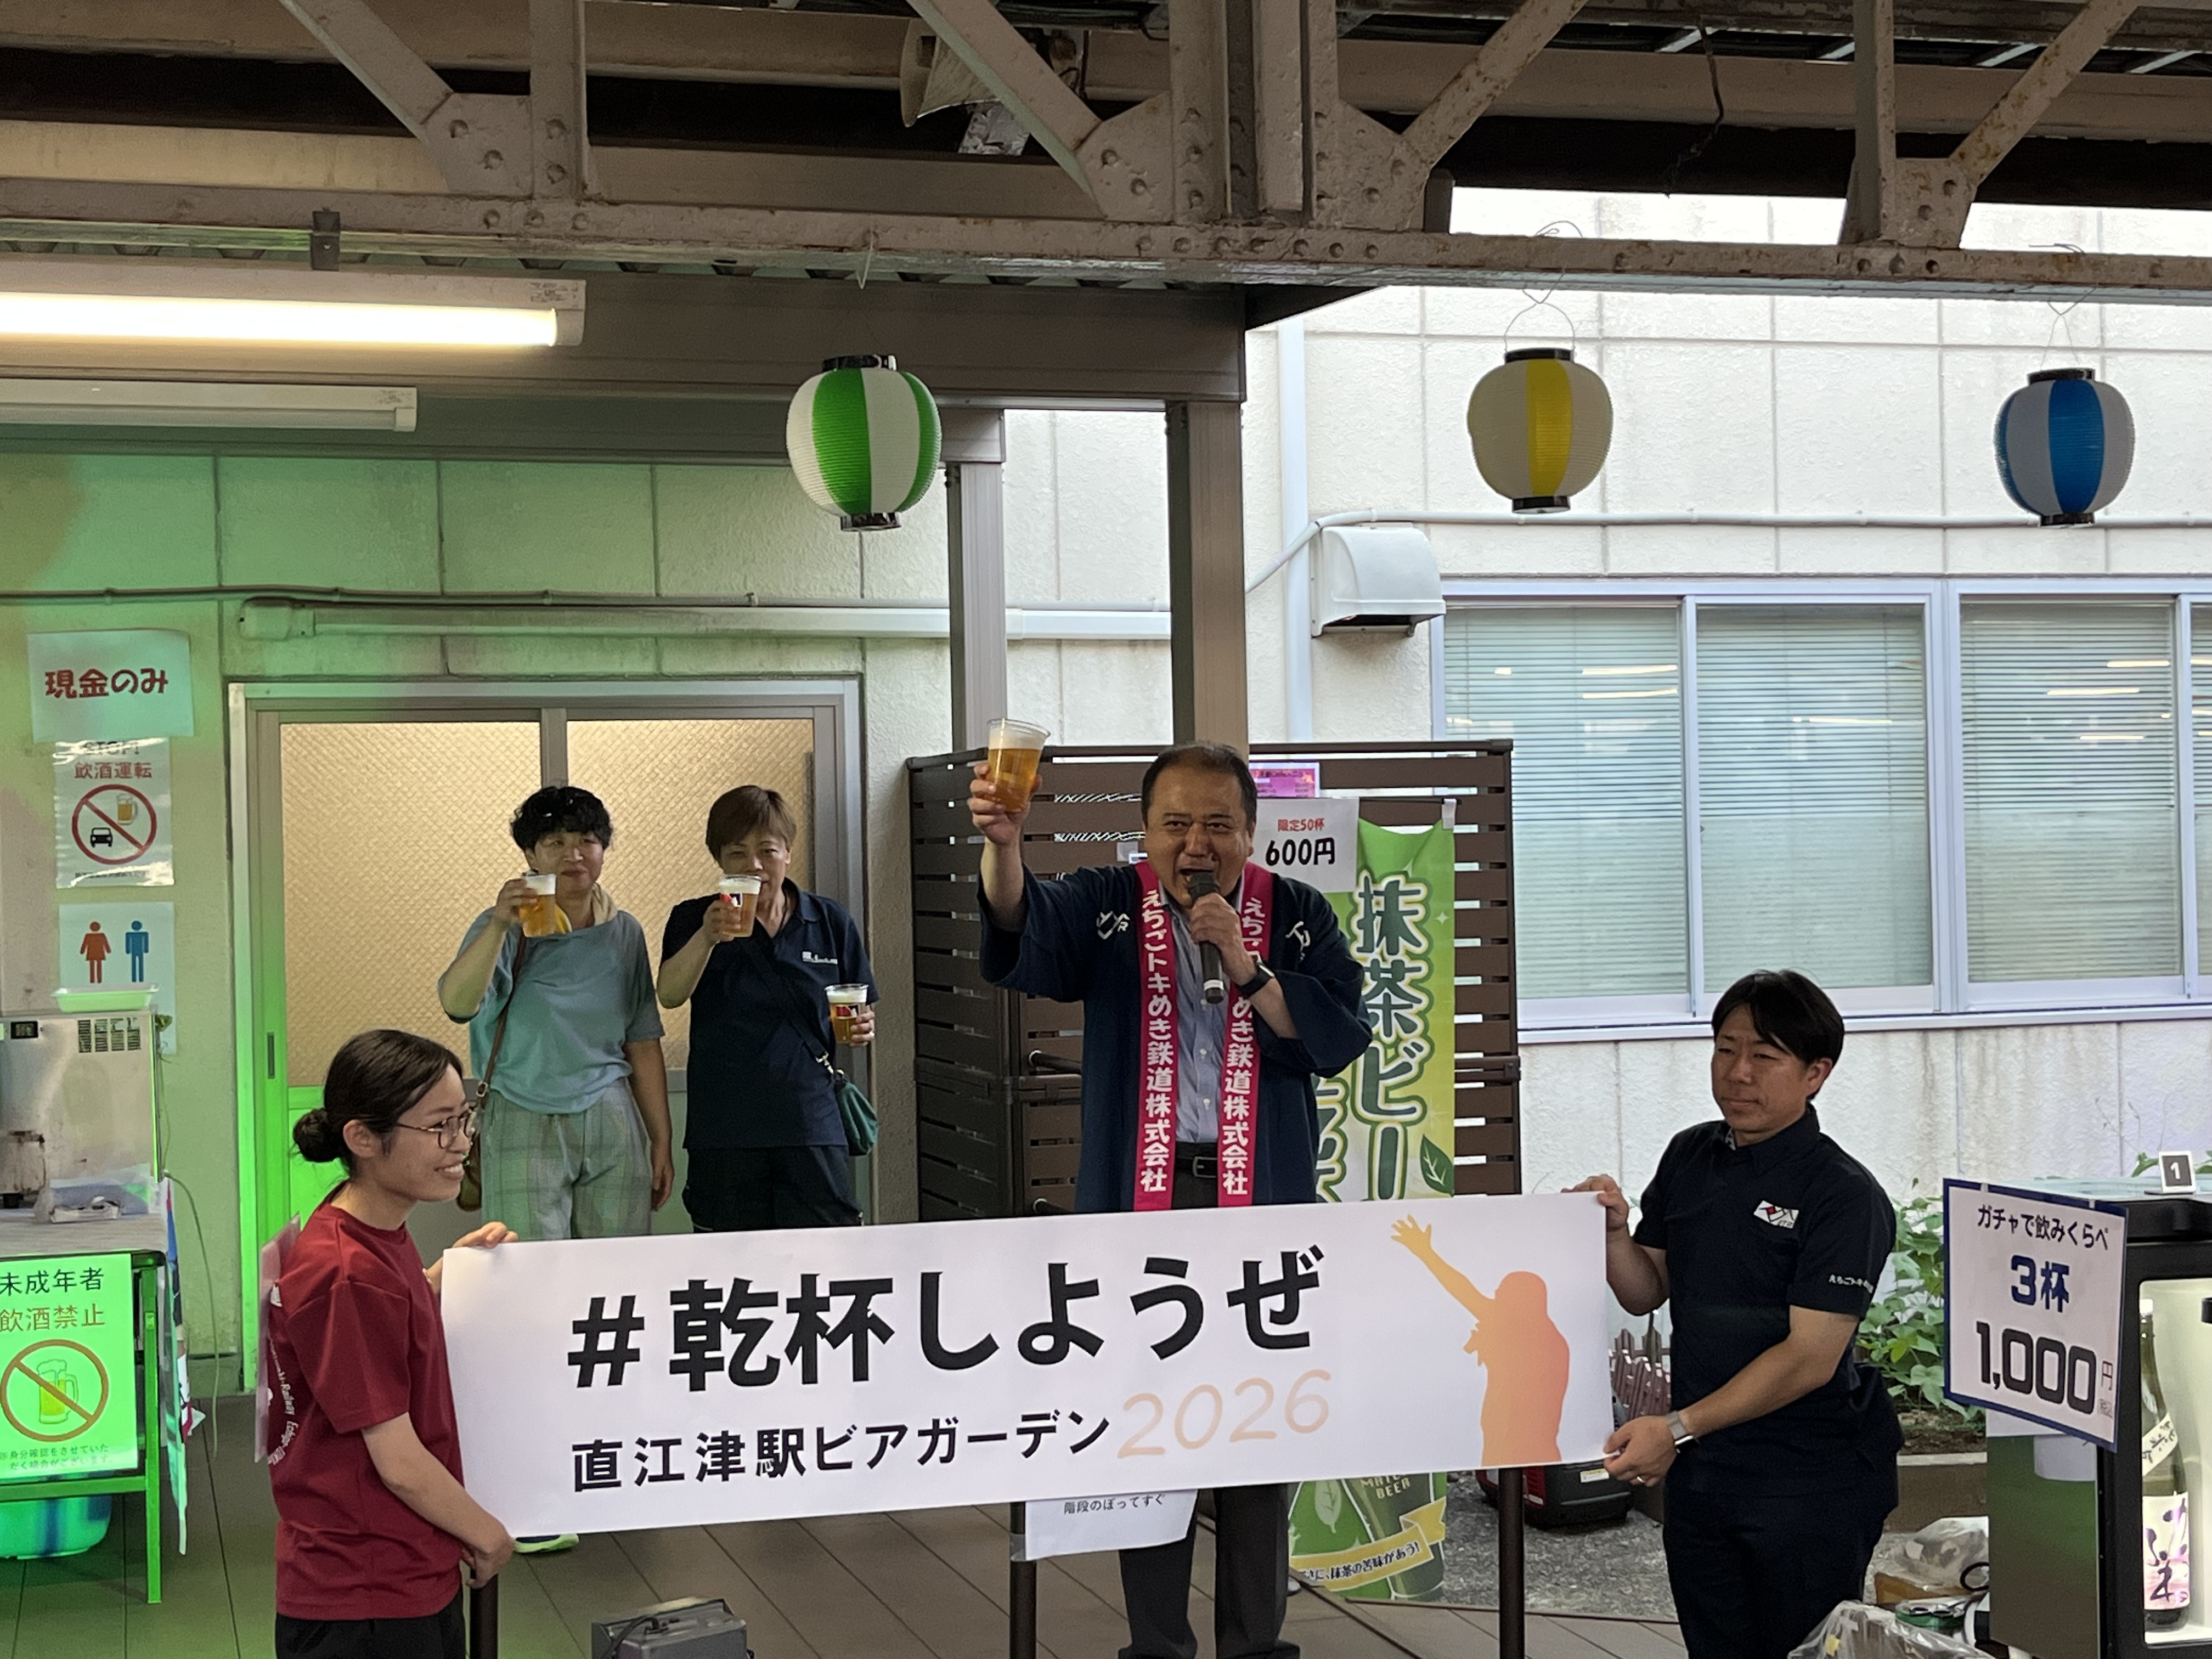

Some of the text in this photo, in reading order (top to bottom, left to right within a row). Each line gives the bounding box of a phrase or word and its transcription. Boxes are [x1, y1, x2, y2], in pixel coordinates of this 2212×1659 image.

[45, 668, 168, 699] 現金のみ
[74, 761, 153, 779] 飲酒運転
[1277, 817, 1325, 832] 限定50杯
[1265, 837, 1336, 866] 600円
[1141, 889, 1175, 1193] えちごトキめき鉄道株式会社
[1221, 896, 1266, 1196] えちごめき鉄道株式会社
[2170, 1161, 2181, 1180] 1
[1977, 1204, 2109, 1251] ガチャで飲みくらべ
[0, 1267, 104, 1296] 未成年者
[2011, 1254, 2070, 1313] 3杯
[0, 1303, 106, 1333] 飲酒禁止
[1375, 1477, 1411, 1499] BEER
[1064, 1493, 1165, 1515] 階段のぼってすぐ
